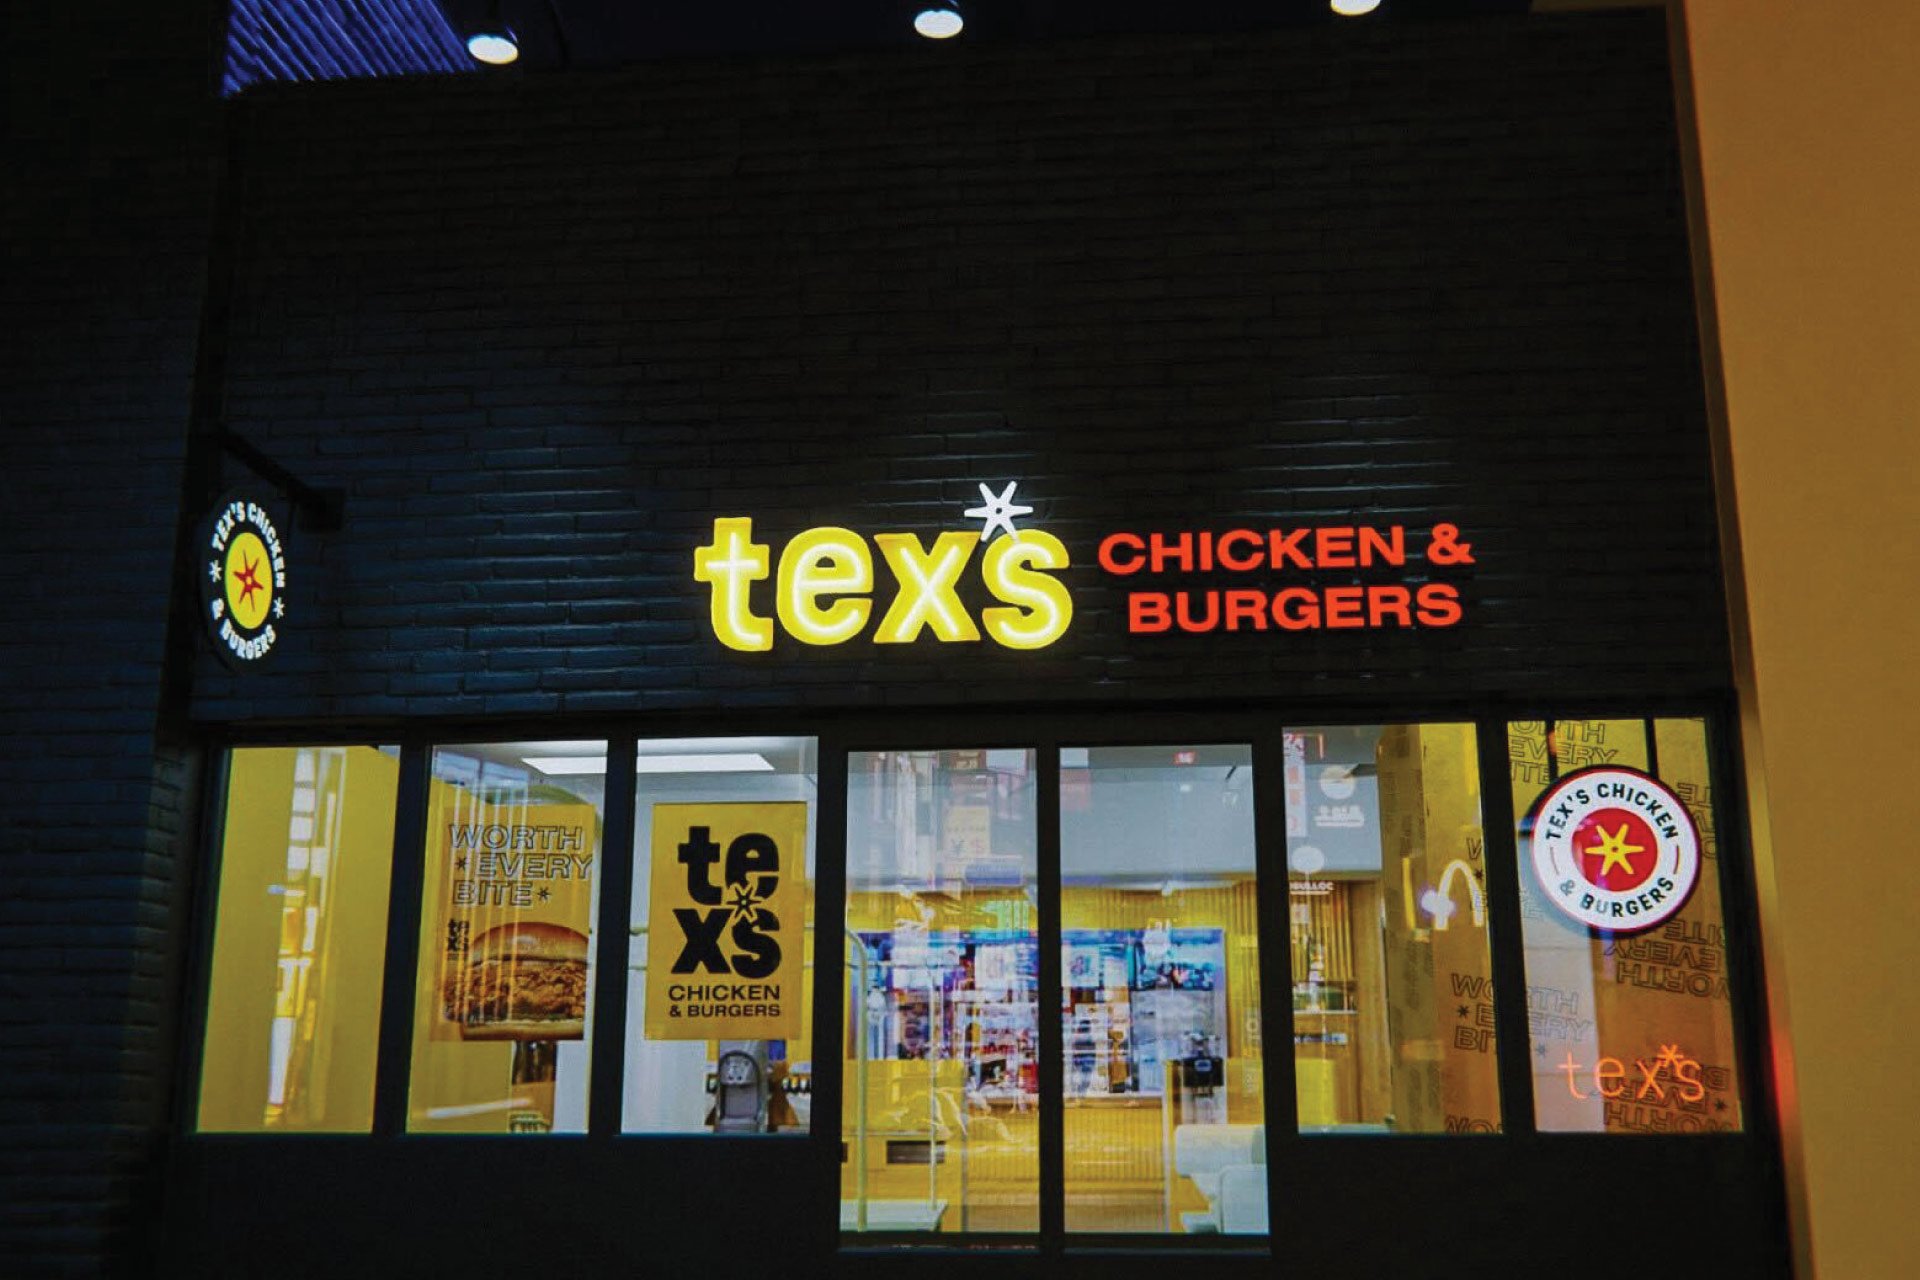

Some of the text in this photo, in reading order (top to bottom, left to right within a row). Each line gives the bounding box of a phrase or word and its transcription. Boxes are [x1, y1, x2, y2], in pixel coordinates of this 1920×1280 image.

[211, 501, 286, 588] TEX'S CHICKEN
[1098, 521, 1476, 576] CHICKEN &
[1129, 583, 1463, 634] BURGERS
[220, 618, 277, 660] BURGERS
[1545, 788, 1591, 841] TEX'S
[1596, 783, 1679, 840] CHICKEN
[448, 824, 583, 850] WORTH
[1559, 878, 1575, 897] &
[1580, 876, 1674, 918] BURGERS
[668, 984, 780, 1002] CHICKEN
[669, 1004, 781, 1018] & BURGERS
